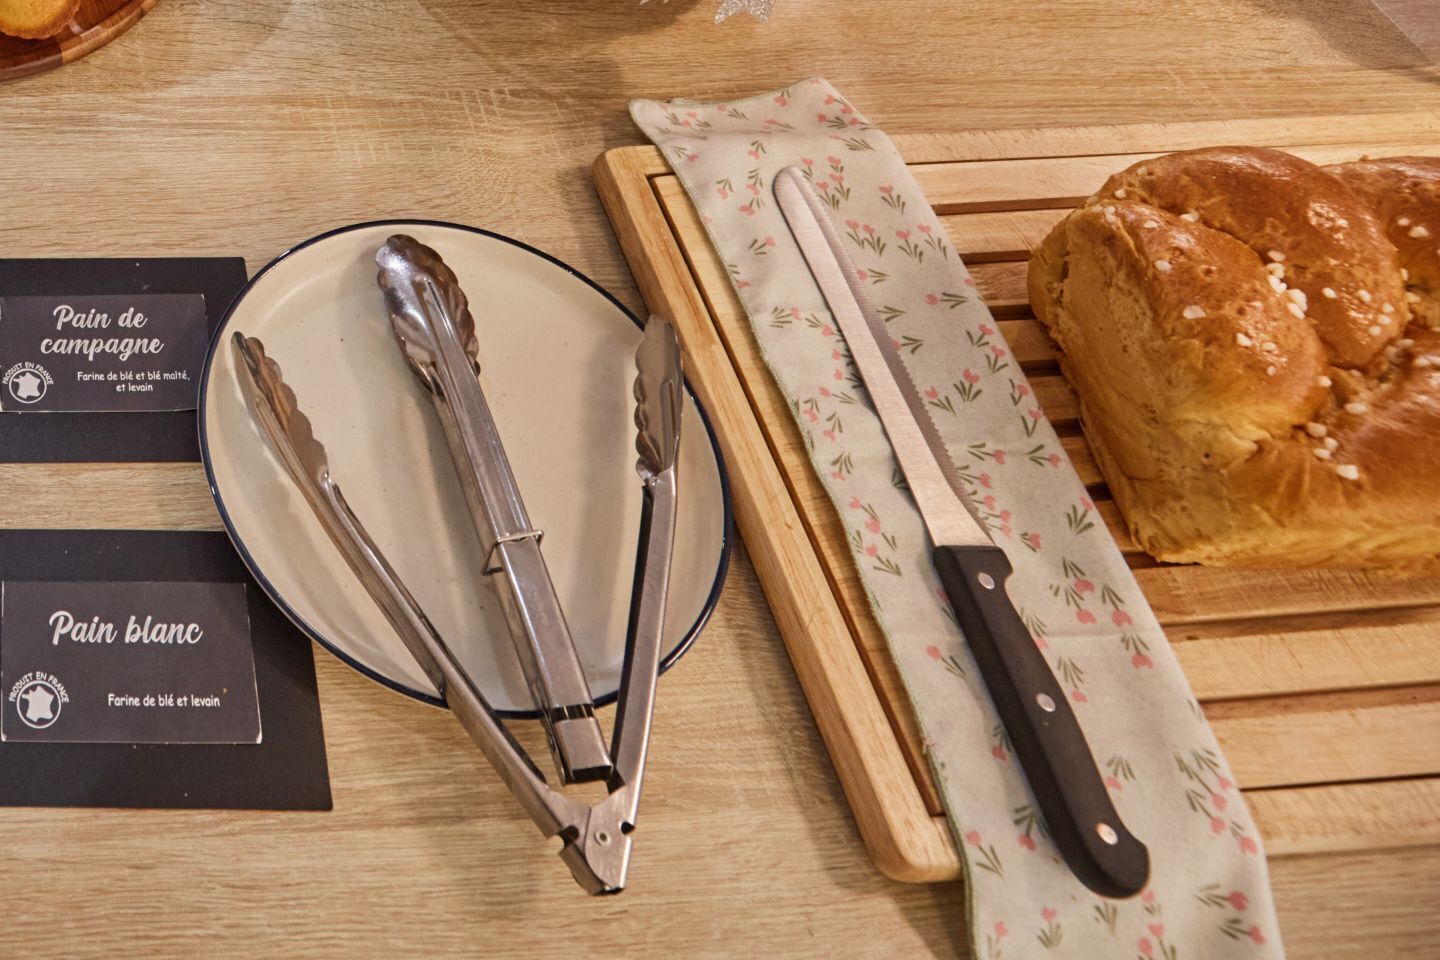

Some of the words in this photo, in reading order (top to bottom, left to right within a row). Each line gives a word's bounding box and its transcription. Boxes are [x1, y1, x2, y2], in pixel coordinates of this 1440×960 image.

[52, 304, 111, 331] Pain
[117, 306, 148, 329] de
[40, 337, 165, 362] campagne
[1, 362, 24, 386] PRODUIT
[24, 361, 35, 370] EN
[35, 364, 55, 386] FRANCE
[77, 371, 105, 381] Farine
[107, 371, 118, 381] de
[120, 370, 134, 381] blé
[135, 372, 146, 381] et
[147, 370, 161, 381] blé
[163, 369, 191, 382] malté,
[116, 383, 126, 392] et
[128, 382, 154, 392] levain
[48, 610, 118, 646] Pain
[124, 615, 203, 645] blanc
[8, 672, 34, 702] PRODUIT
[35, 671, 48, 681] EN
[47, 674, 70, 703] FRANCE
[107, 693, 141, 707] Farine
[142, 693, 156, 707] de
[158, 693, 175, 707] blé
[176, 695, 188, 707] et
[190, 693, 221, 707] levain
